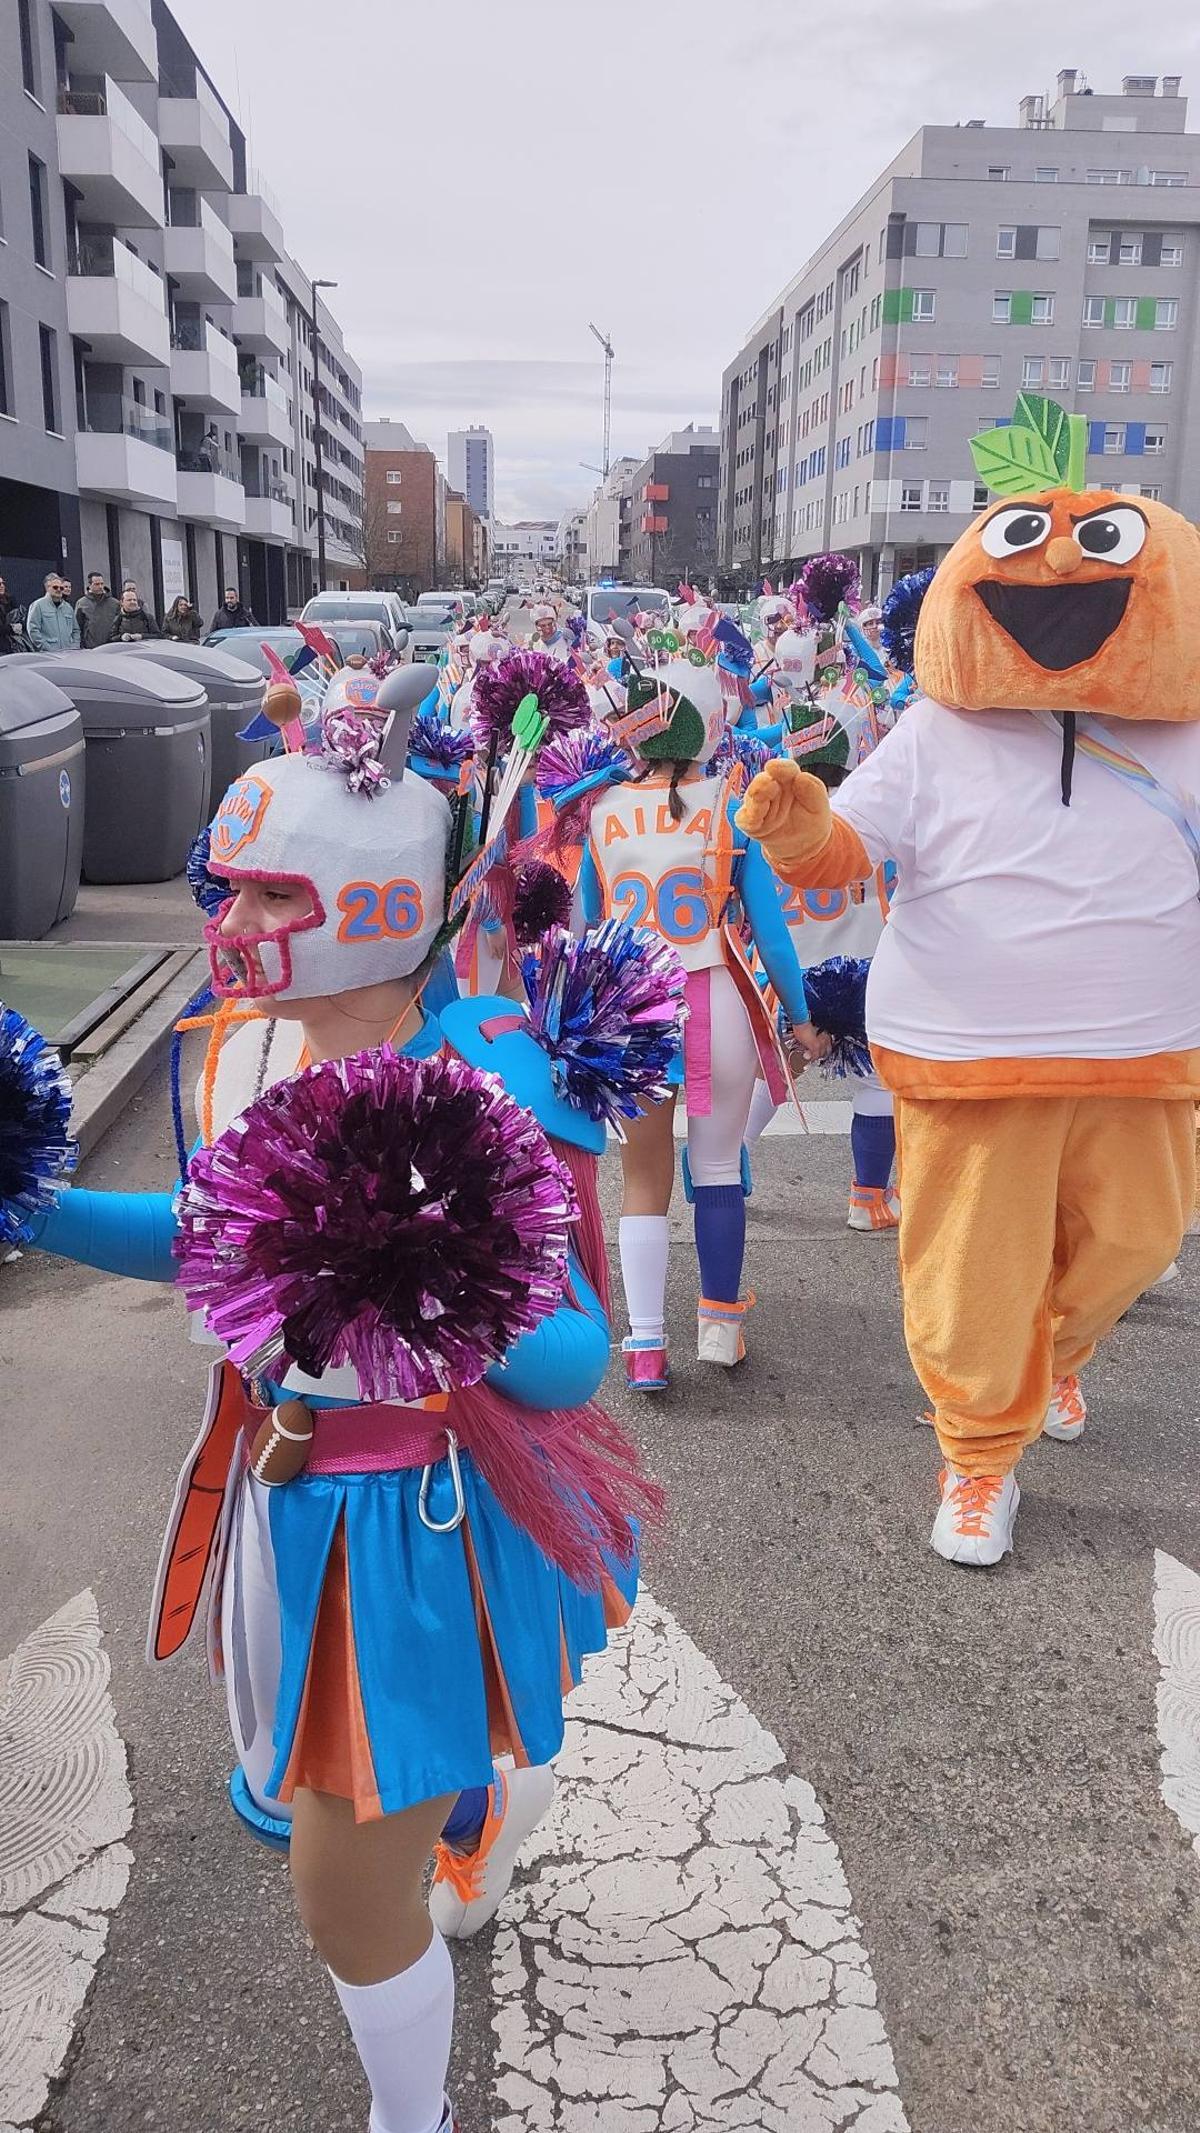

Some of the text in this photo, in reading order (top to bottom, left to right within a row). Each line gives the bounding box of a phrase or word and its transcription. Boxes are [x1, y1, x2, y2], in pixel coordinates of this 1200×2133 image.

[604, 804, 713, 846] AIDA
[341, 880, 421, 941] 26
[612, 869, 712, 943] 26
